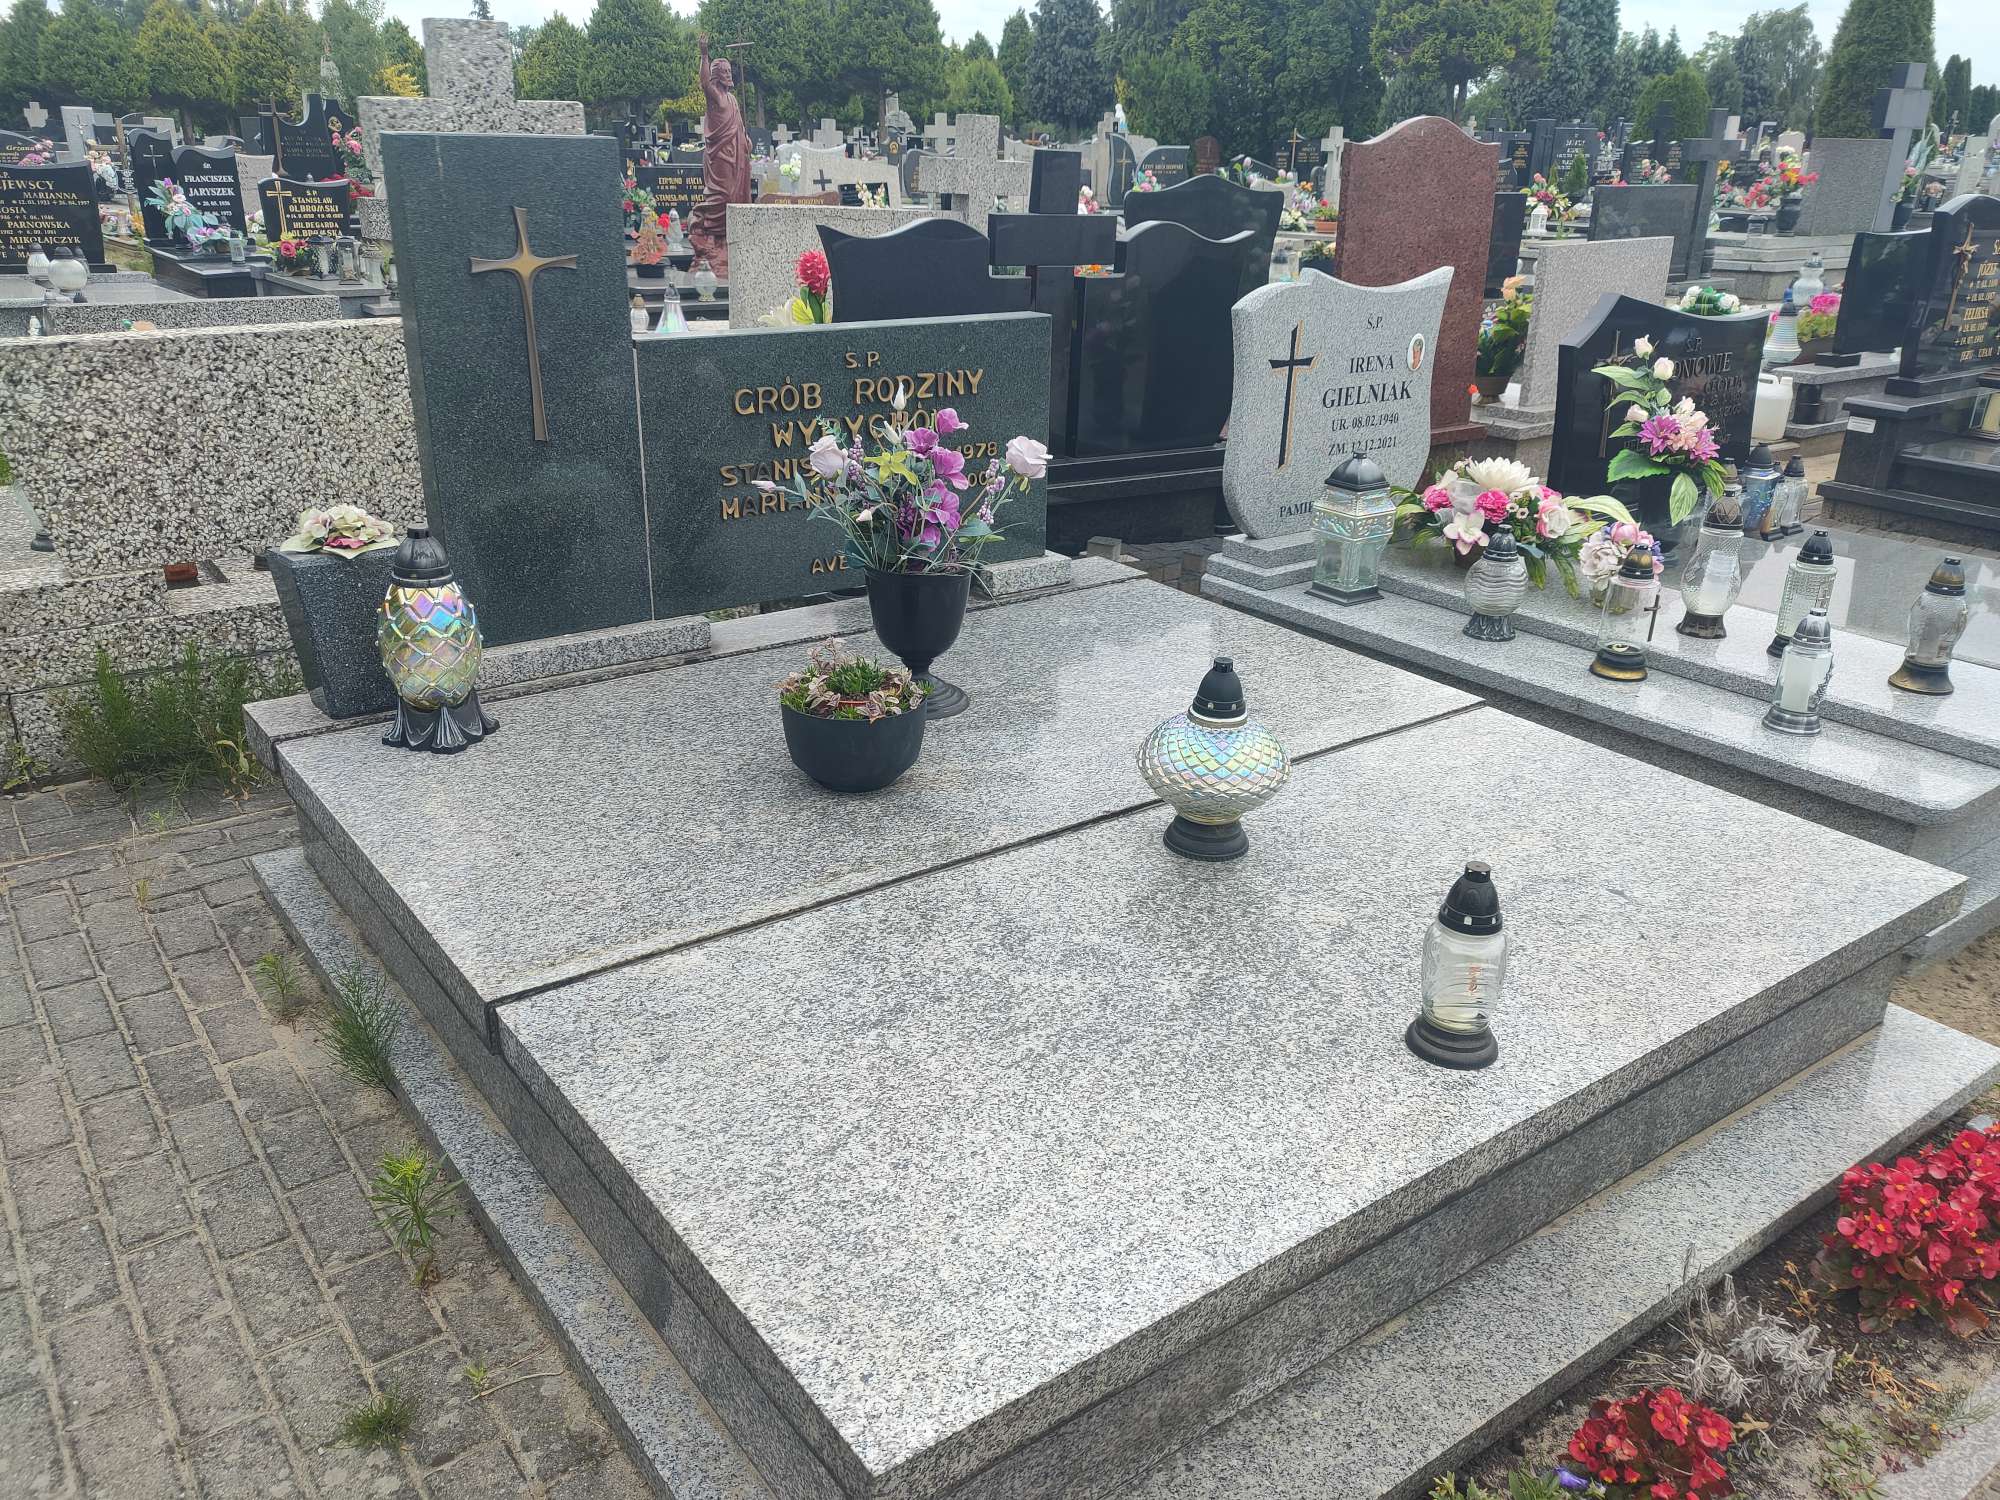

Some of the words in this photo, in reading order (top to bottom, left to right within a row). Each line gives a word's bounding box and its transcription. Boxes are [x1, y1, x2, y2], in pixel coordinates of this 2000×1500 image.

[0, 180, 55, 191] JEWSCY
[23, 191, 78, 200] MARIANNA
[188, 187, 235, 196] JARYSZEK
[7, 220, 71, 229] PARNOWSKA
[1350, 355, 1394, 374] IRENA
[734, 376, 823, 415] GRÓB
[854, 368, 984, 404] RODZINY
[1322, 380, 1413, 409] GIELNIAK
